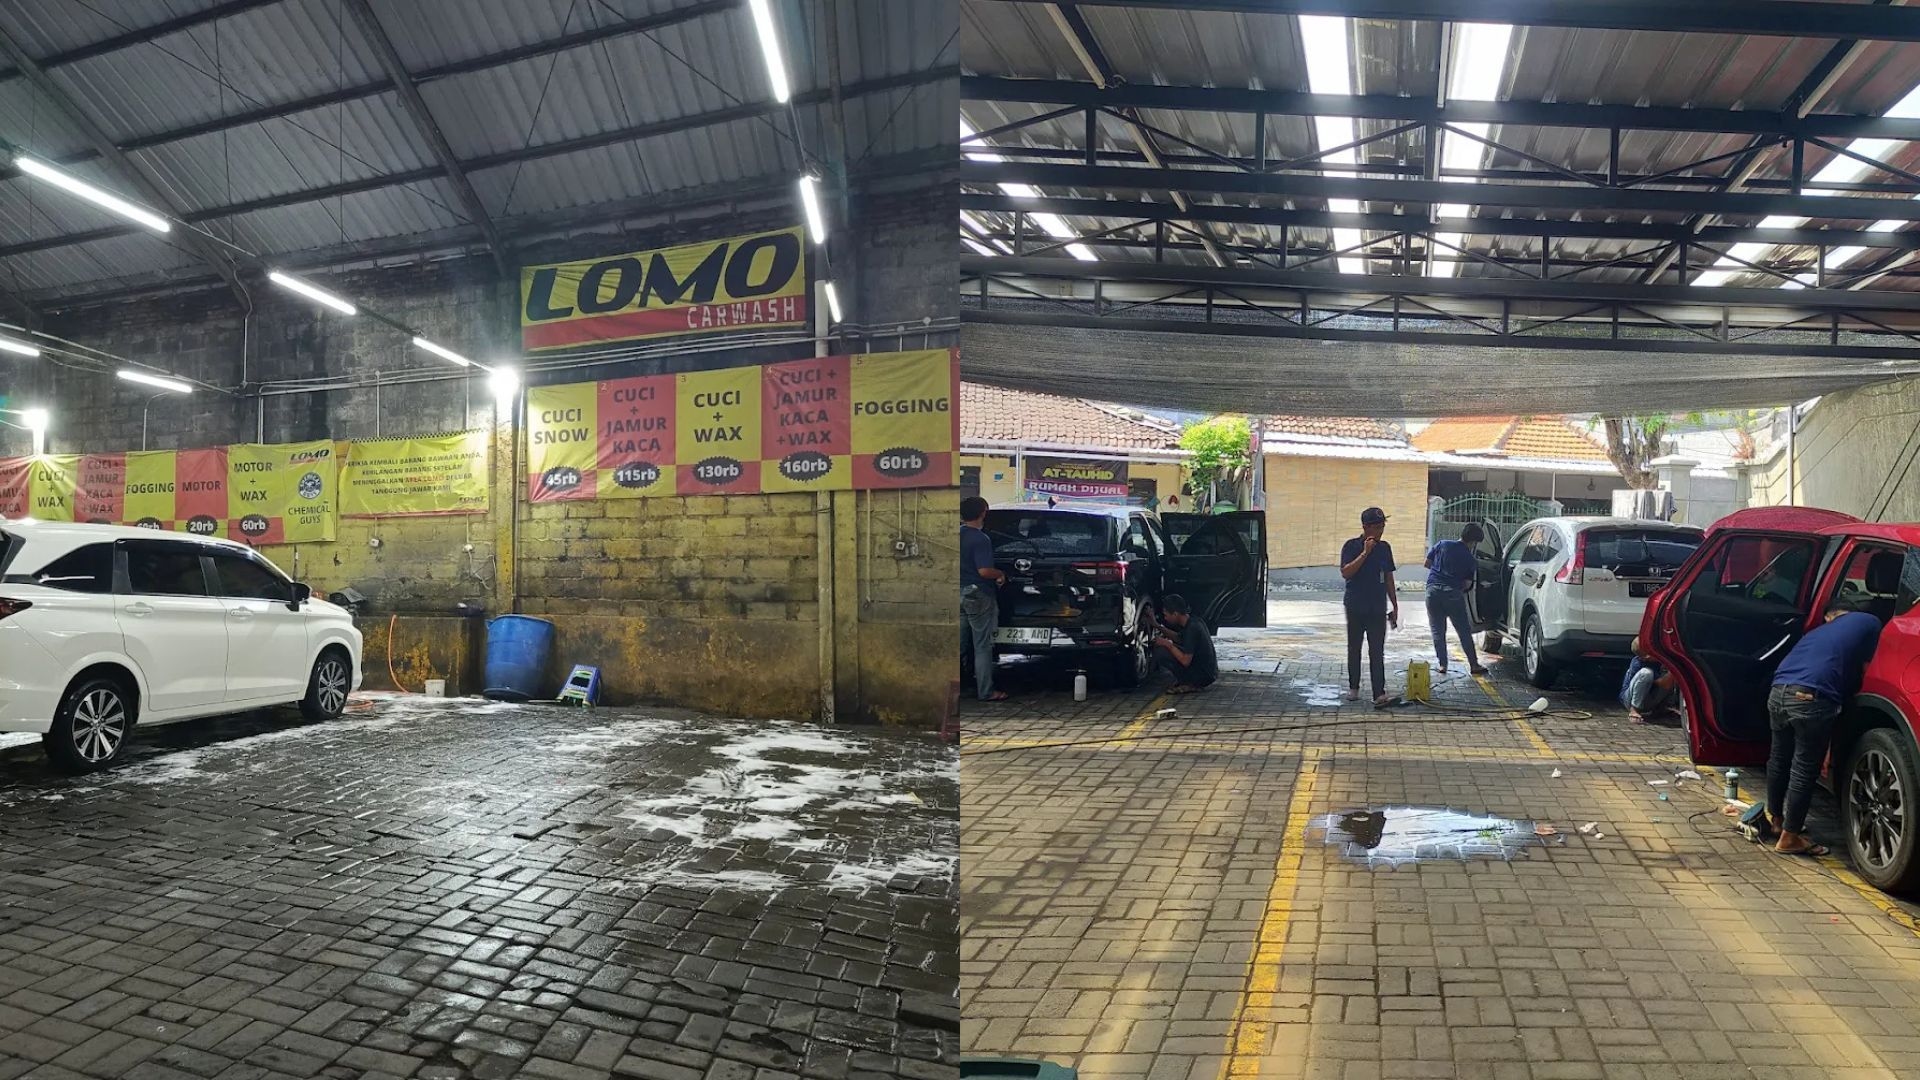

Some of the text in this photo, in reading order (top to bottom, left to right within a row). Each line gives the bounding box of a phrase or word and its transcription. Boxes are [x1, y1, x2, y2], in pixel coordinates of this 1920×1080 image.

[526, 232, 800, 322] LOMO
[687, 297, 796, 329] CARWASH
[681, 375, 686, 383] 3
[779, 370, 821, 386] CUCI
[602, 383, 608, 391] 2
[613, 386, 655, 403] CUCI
[694, 390, 741, 408] CUCI
[773, 387, 838, 410] JAMUR
[854, 398, 949, 416] FOGGING
[541, 408, 582, 424] CUCI
[712, 411, 723, 422] +
[780, 409, 828, 426] KACA
[605, 417, 667, 437] JAMUR
[694, 425, 743, 443] WAX
[534, 428, 589, 445] SNOW
[613, 438, 661, 454] KACA
[290, 449, 330, 461] LOMO
[879, 454, 922, 470] 60rb
[233, 462, 273, 472] MOTOR
[697, 463, 740, 478] 130rb
[783, 457, 828, 473] 160rb
[546, 472, 578, 486] 45rb
[616, 469, 657, 482] 115rb
[1042, 467, 1115, 480] AT-TAUHID
[126, 482, 174, 494] FOGGING
[182, 481, 221, 492] MOTOR
[1029, 481, 1124, 495] RUMAH DIJUAL
[37, 496, 65, 508] WAX
[240, 490, 268, 500] WAX
[288, 504, 331, 516] CHEMICAL
[190, 521, 214, 532] 20rb
[242, 520, 266, 531] 60rb
[300, 515, 321, 525] GUYS
